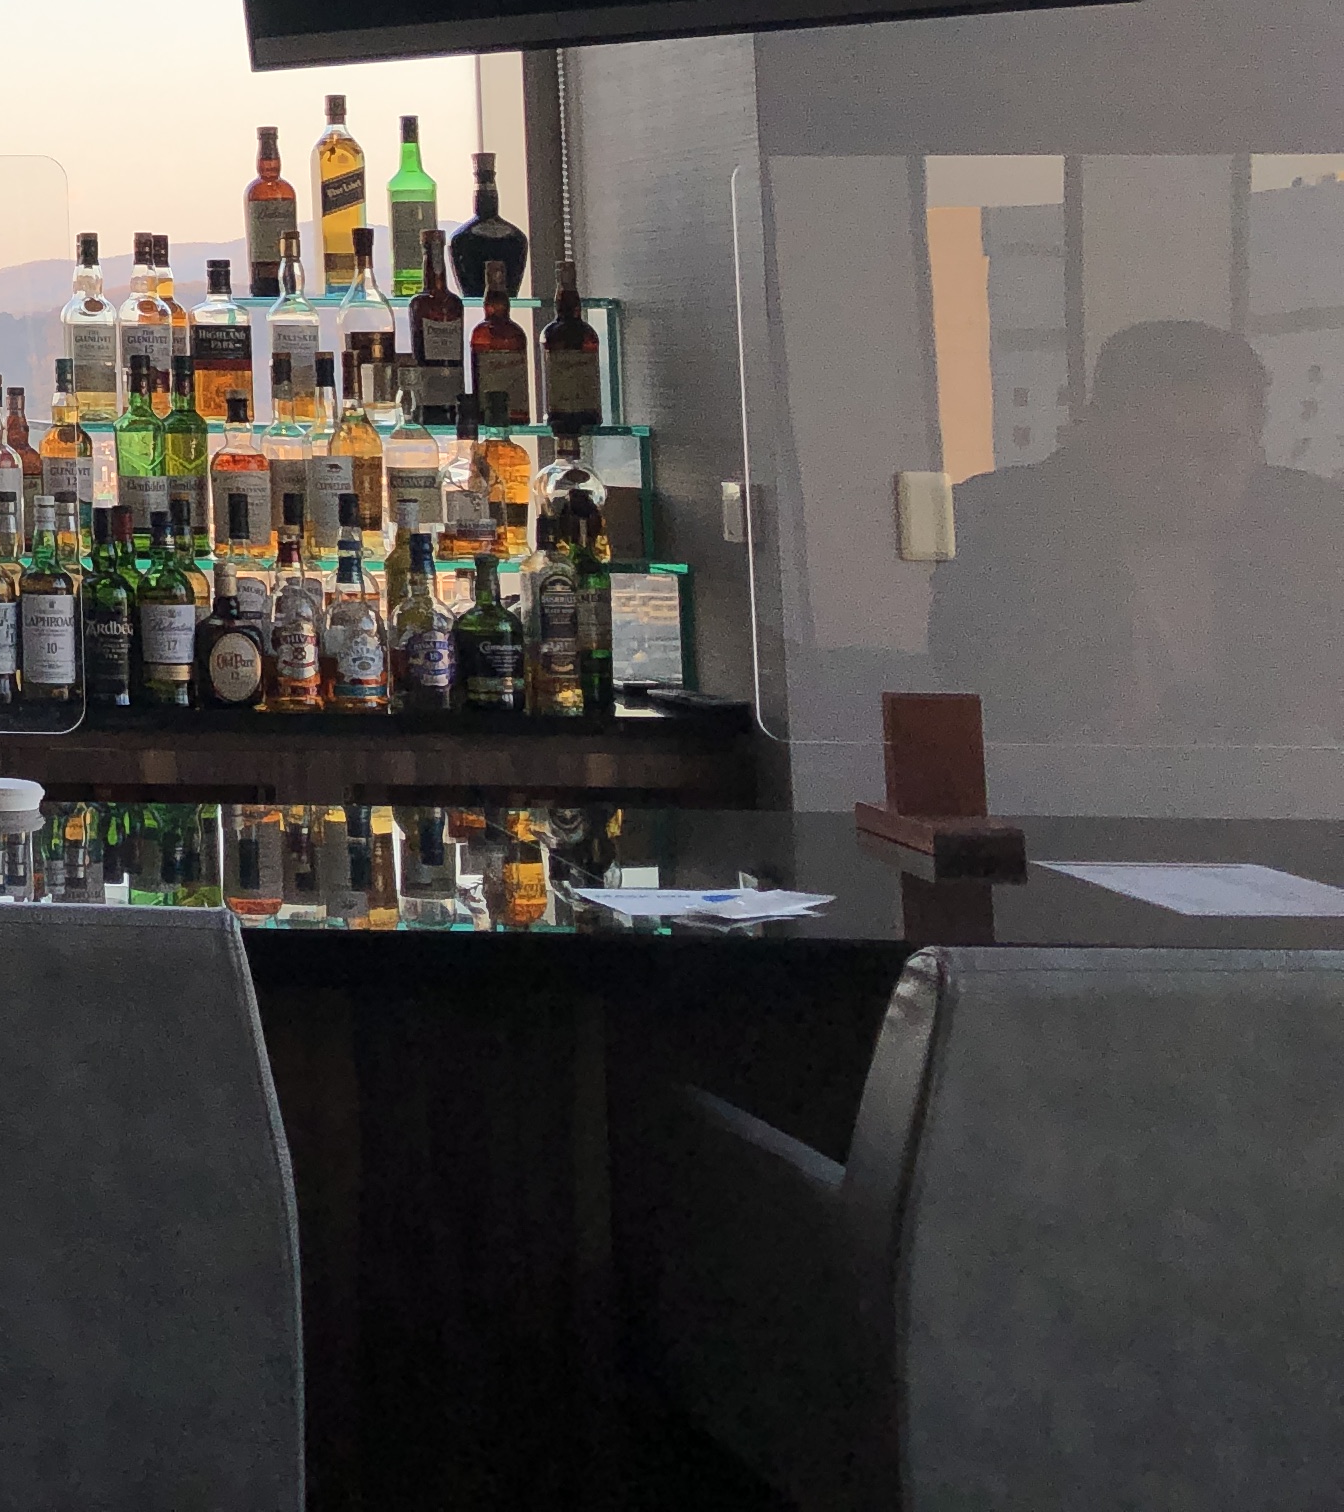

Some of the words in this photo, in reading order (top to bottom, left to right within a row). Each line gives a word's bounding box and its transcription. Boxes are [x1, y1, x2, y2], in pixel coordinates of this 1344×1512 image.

[127, 335, 168, 345] GLENLIVET
[198, 329, 246, 340] HIGHLAND
[144, 345, 155, 354] 15
[46, 642, 57, 654] 10
[167, 640, 178, 651] 17
